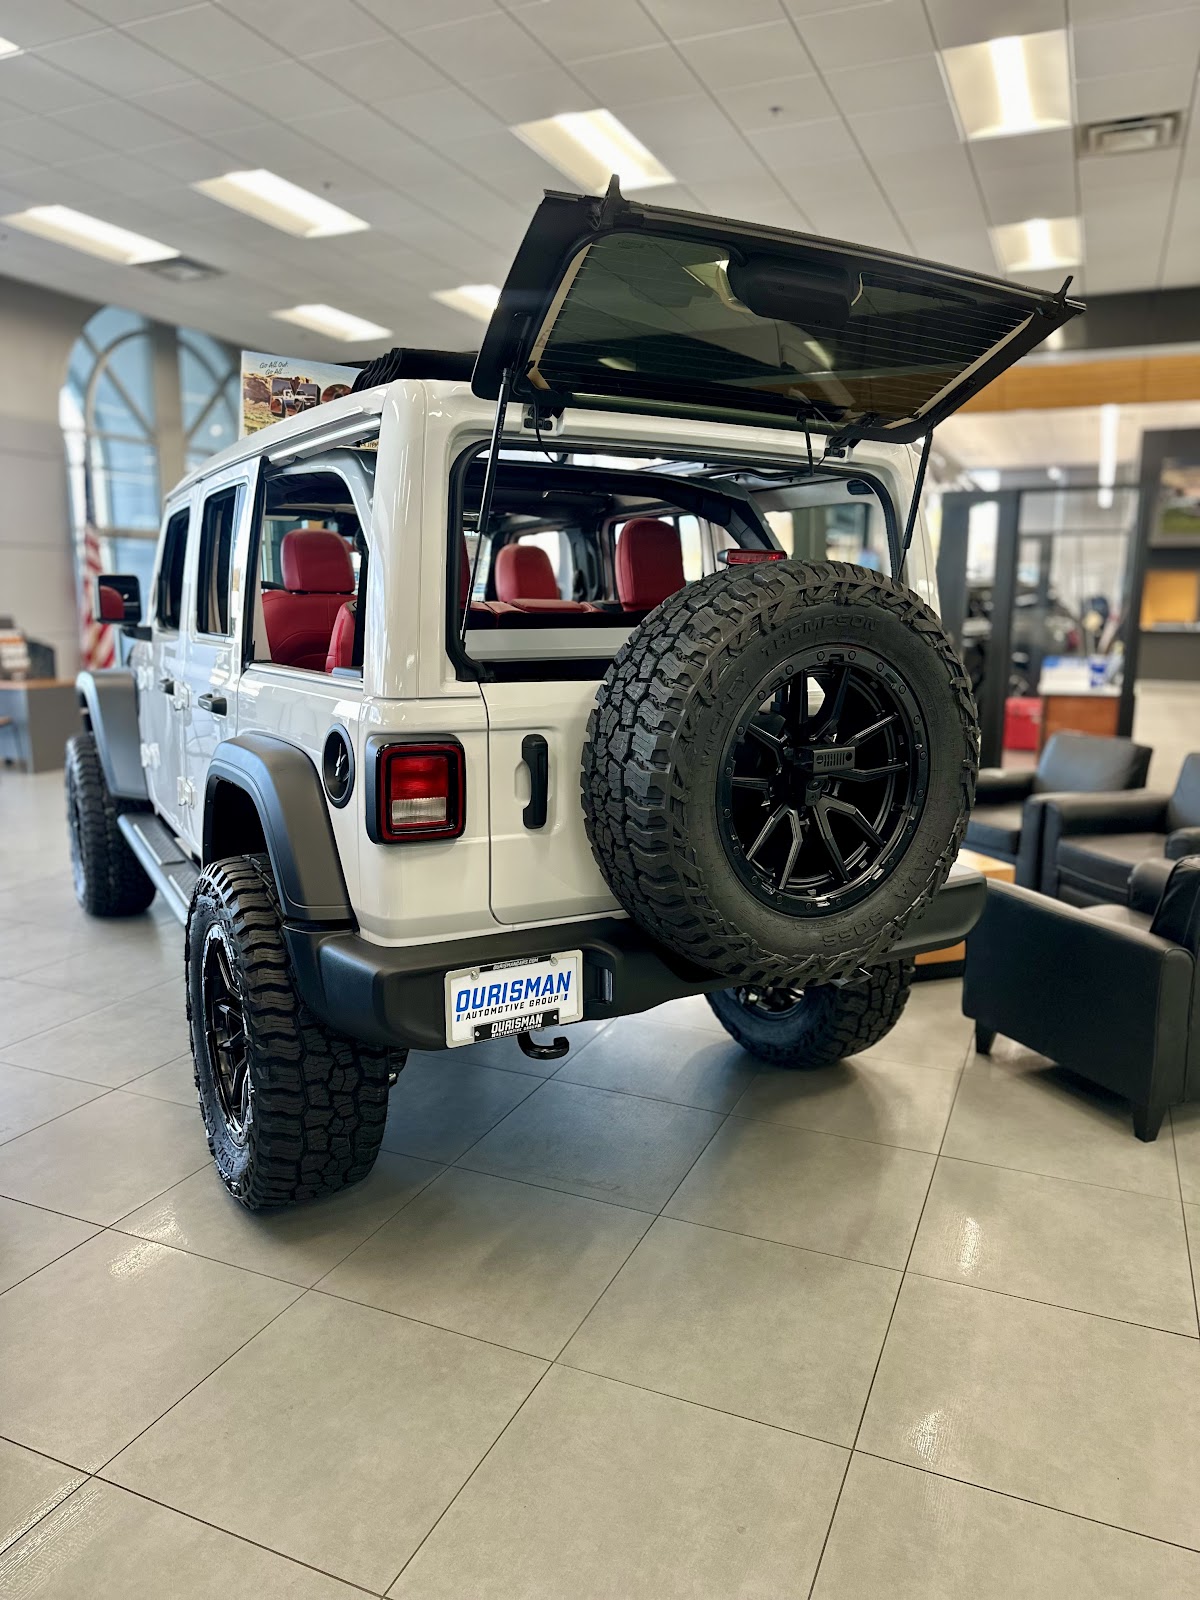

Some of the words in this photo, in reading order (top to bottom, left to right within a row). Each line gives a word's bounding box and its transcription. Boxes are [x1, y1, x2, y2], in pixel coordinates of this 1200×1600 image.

[762, 613, 880, 656] THOMPSON
[822, 910, 885, 946] BOSS
[455, 970, 572, 1013] OURISMAN
[465, 1001, 525, 1020] AUTOMOTIVE
[529, 995, 559, 1008] GROUP
[491, 1013, 544, 1034] OURISMAN
